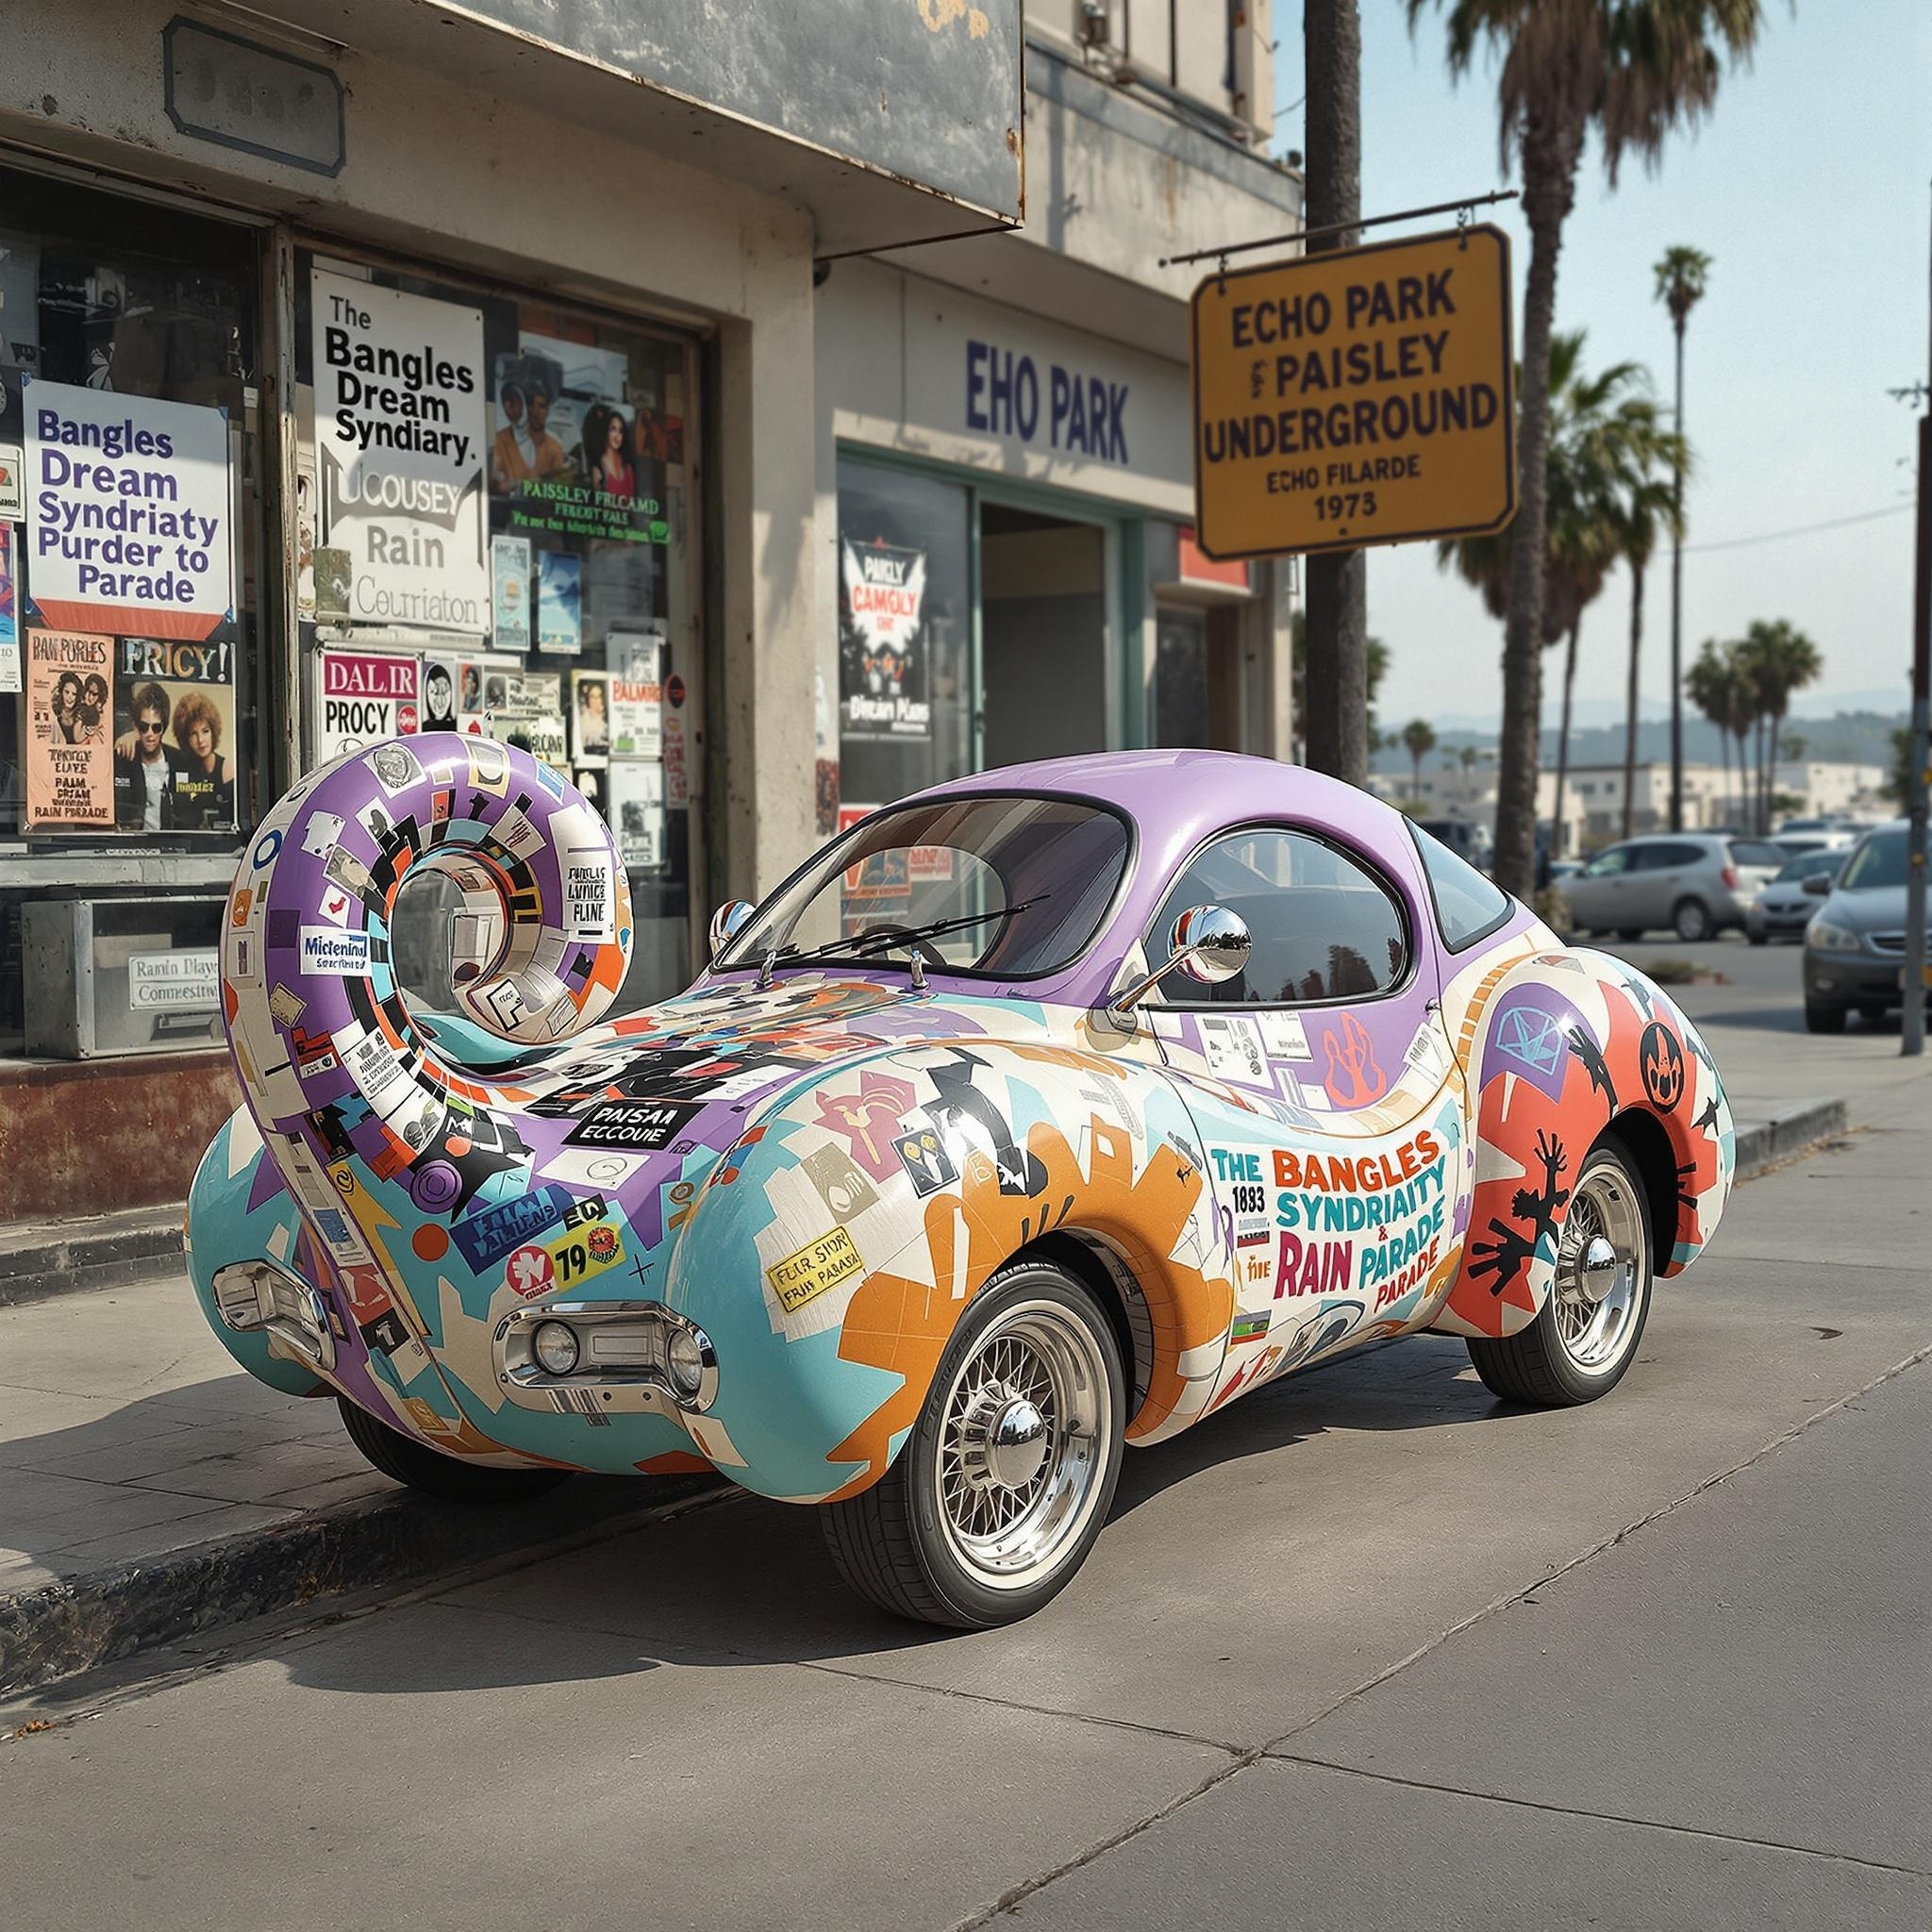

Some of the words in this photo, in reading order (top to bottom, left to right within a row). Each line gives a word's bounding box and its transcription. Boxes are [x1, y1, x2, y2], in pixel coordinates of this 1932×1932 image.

[329, 294, 372, 329] The
[1232, 291, 1331, 348] ECHO
[1347, 268, 1456, 329] PARK
[325, 326, 475, 393] Bangles
[1276, 330, 1451, 396] PAISLEY
[338, 370, 450, 424] Dream
[967, 340, 1039, 442] EHO
[1051, 364, 1129, 465] PARK
[1204, 383, 1498, 463] UNDERGROUND
[38, 408, 174, 458] Bangles
[42, 448, 177, 501] Dream
[1267, 467, 1319, 493] ECHO
[1327, 454, 1422, 486] FILARDE
[39, 491, 219, 547] Syndriaty
[367, 525, 444, 568] Rain
[39, 526, 162, 566] Purder
[175, 544, 209, 573] to
[78, 564, 195, 603] Parade
[325, 701, 389, 734] PROCY
[1211, 1148, 1263, 1183] THE
[1273, 1130, 1440, 1193] BANGLES
[1275, 1155, 1446, 1232] SYNDRIAITY
[1274, 1230, 1352, 1300] RAIN
[1358, 1193, 1446, 1291] PARADE
[1374, 1236, 1440, 1314] PARADE
